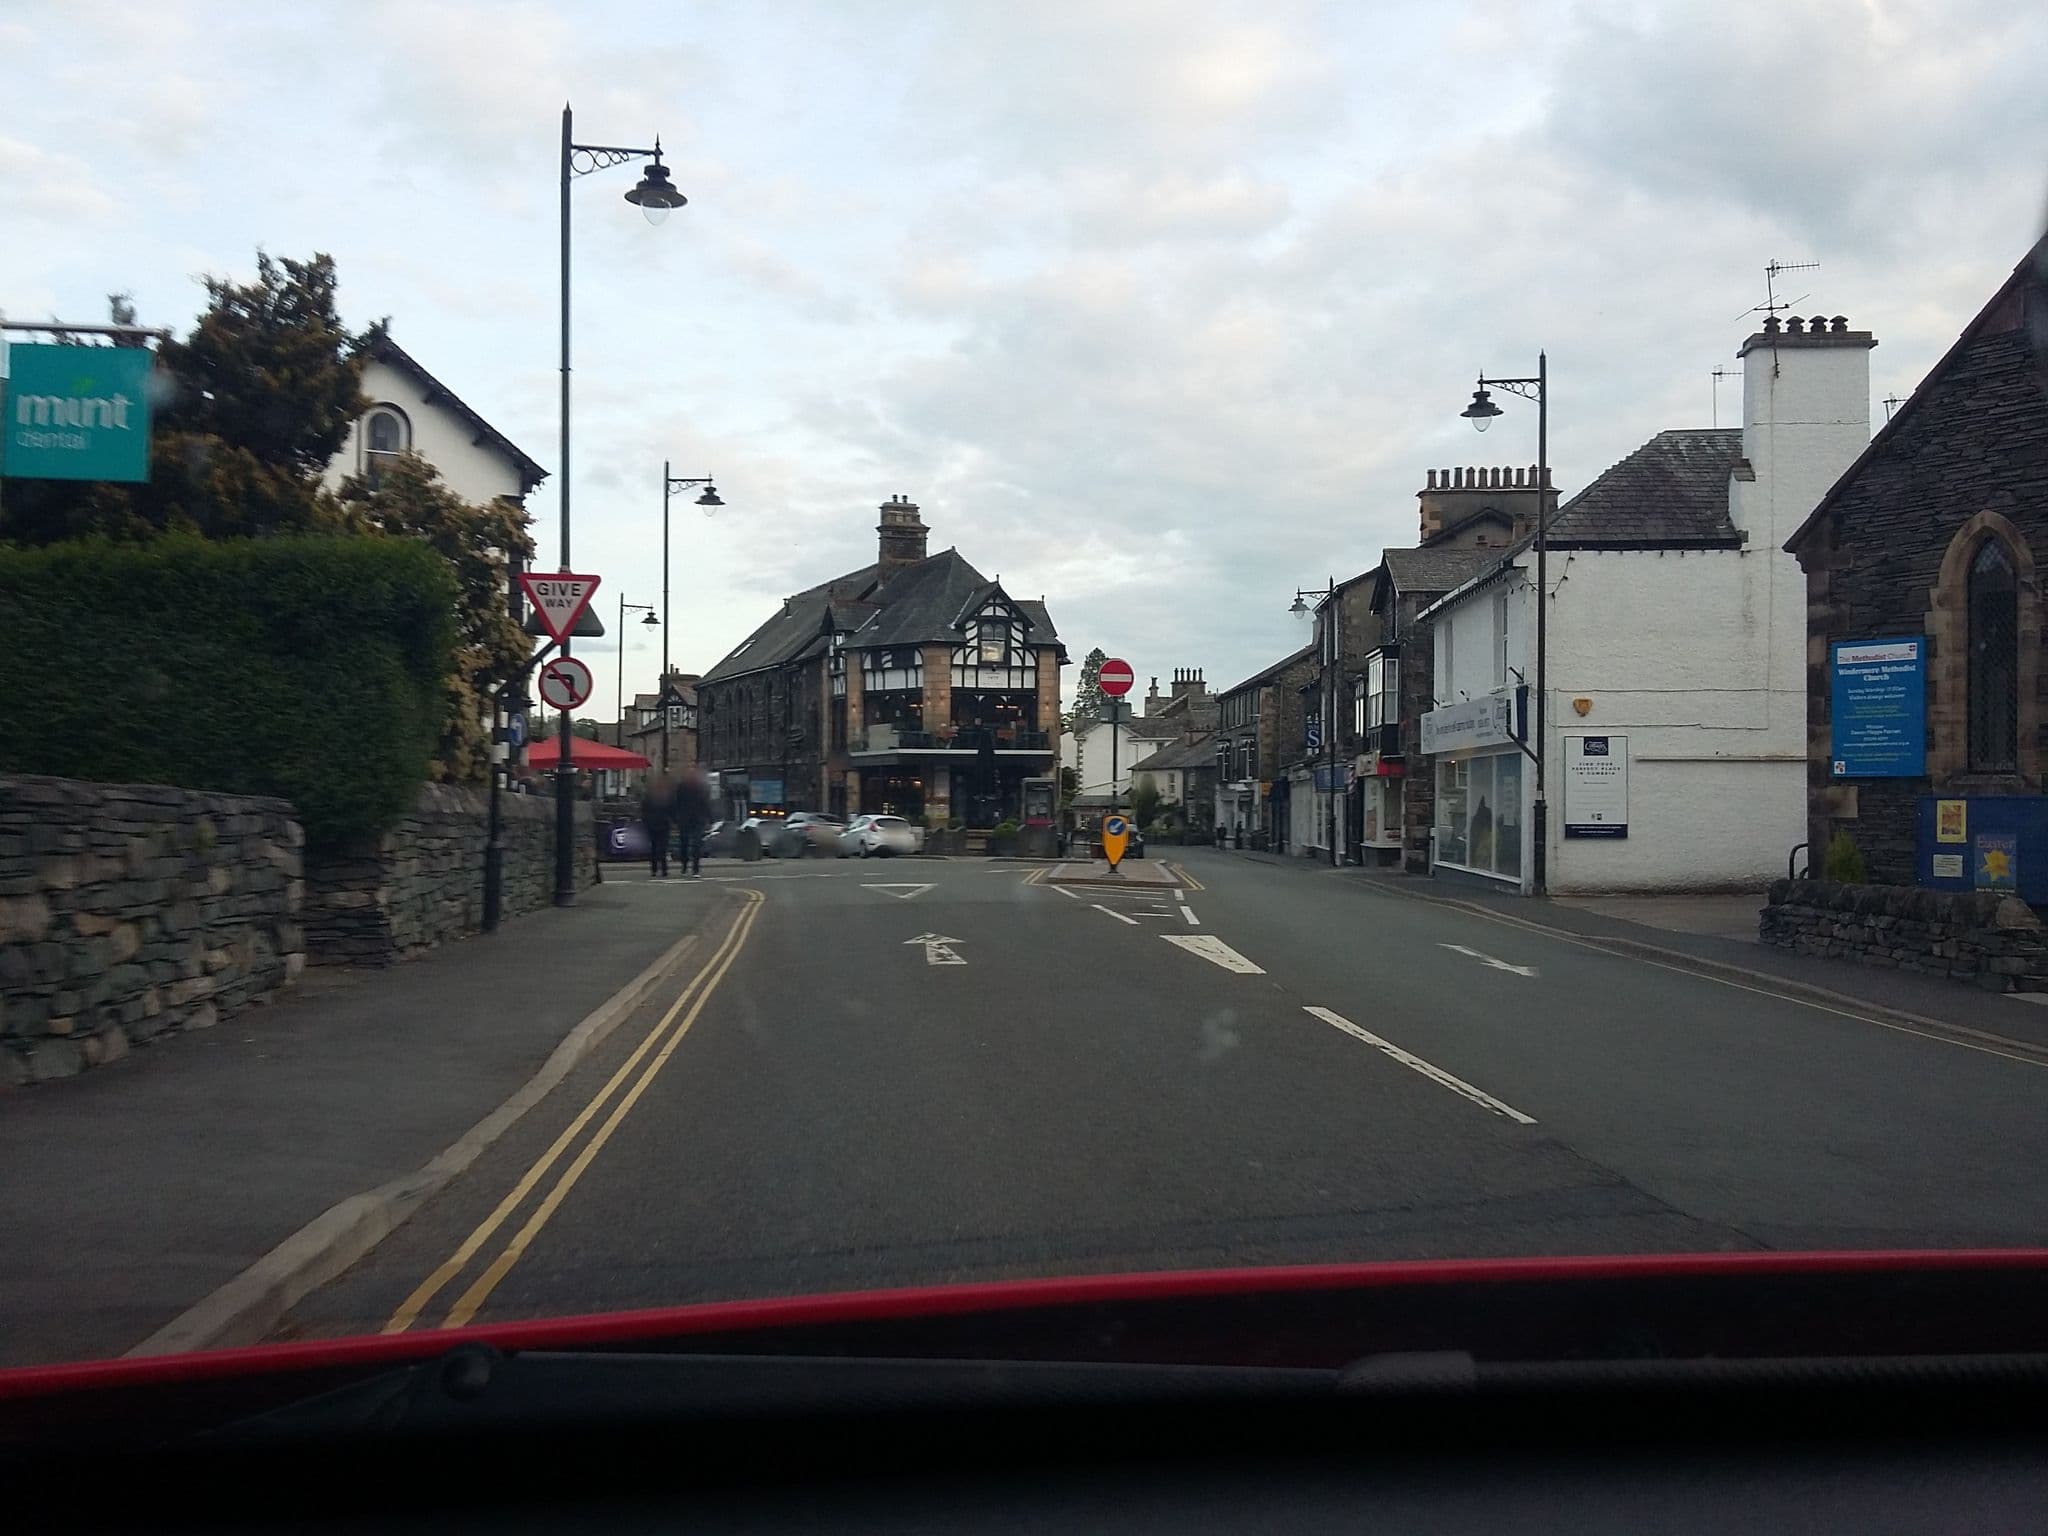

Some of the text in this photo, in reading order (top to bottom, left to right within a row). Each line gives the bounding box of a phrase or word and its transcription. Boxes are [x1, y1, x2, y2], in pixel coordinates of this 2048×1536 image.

[16, 392, 134, 430] mint
[536, 582, 582, 597] GIVE
[545, 598, 574, 608] WAY
[1881, 665, 1916, 673] Methodist
[1863, 673, 1890, 681] Church
